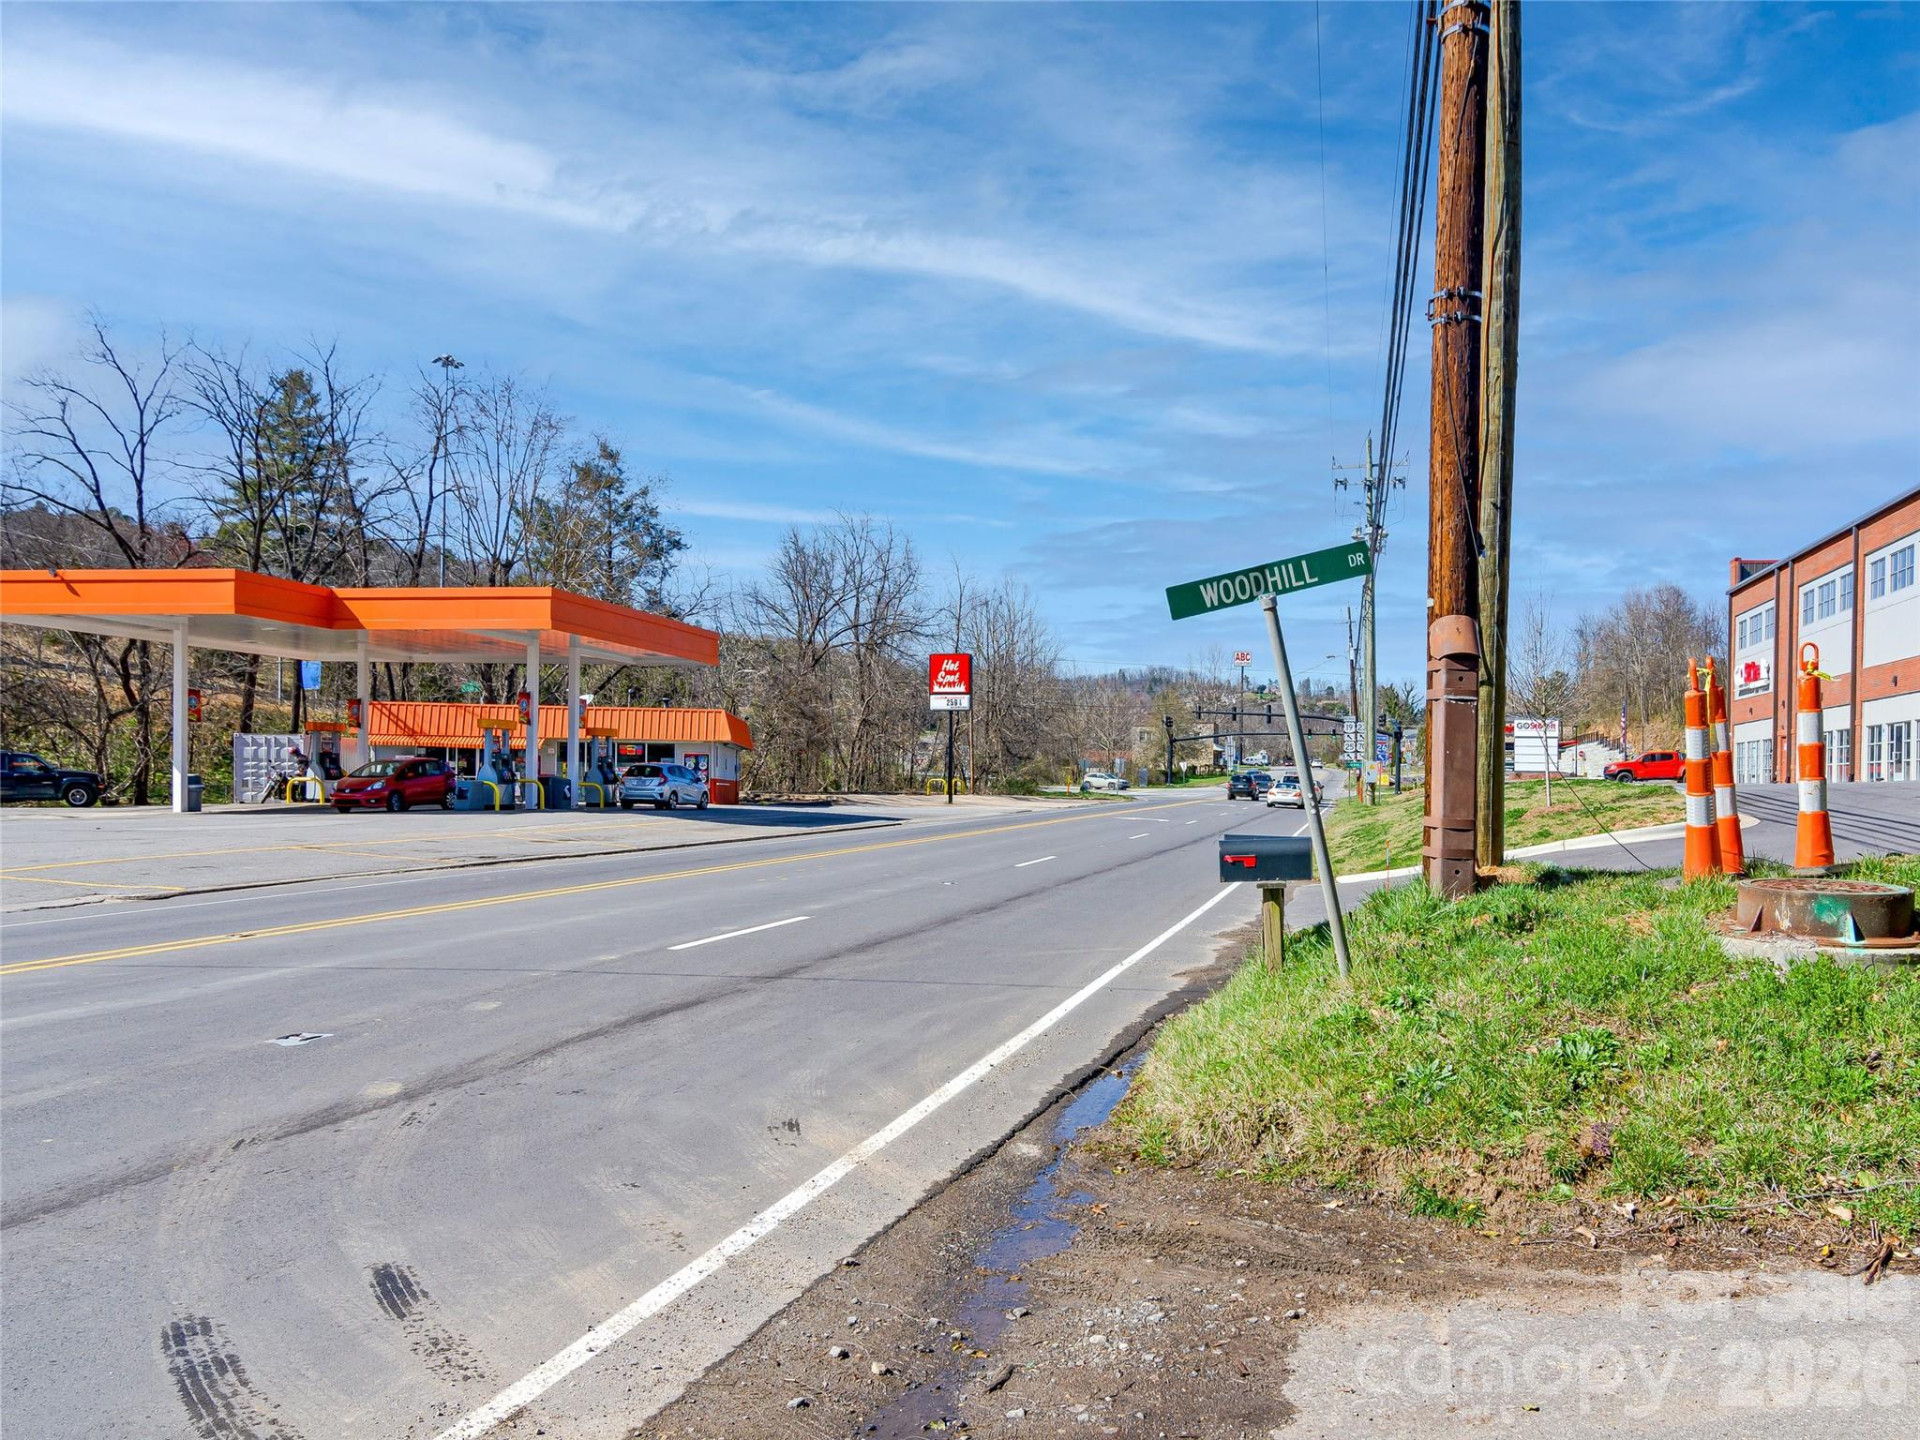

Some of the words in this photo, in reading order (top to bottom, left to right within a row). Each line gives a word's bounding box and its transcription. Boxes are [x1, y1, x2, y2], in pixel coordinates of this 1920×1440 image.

[1200, 560, 1318, 608] WOODHILL
[1348, 552, 1365, 568] DR
[1235, 652, 1251, 661] ABC
[941, 659, 960, 671] Hot
[936, 671, 960, 684] Spot
[1346, 723, 1353, 731] 19
[1345, 743, 1354, 751] 25
